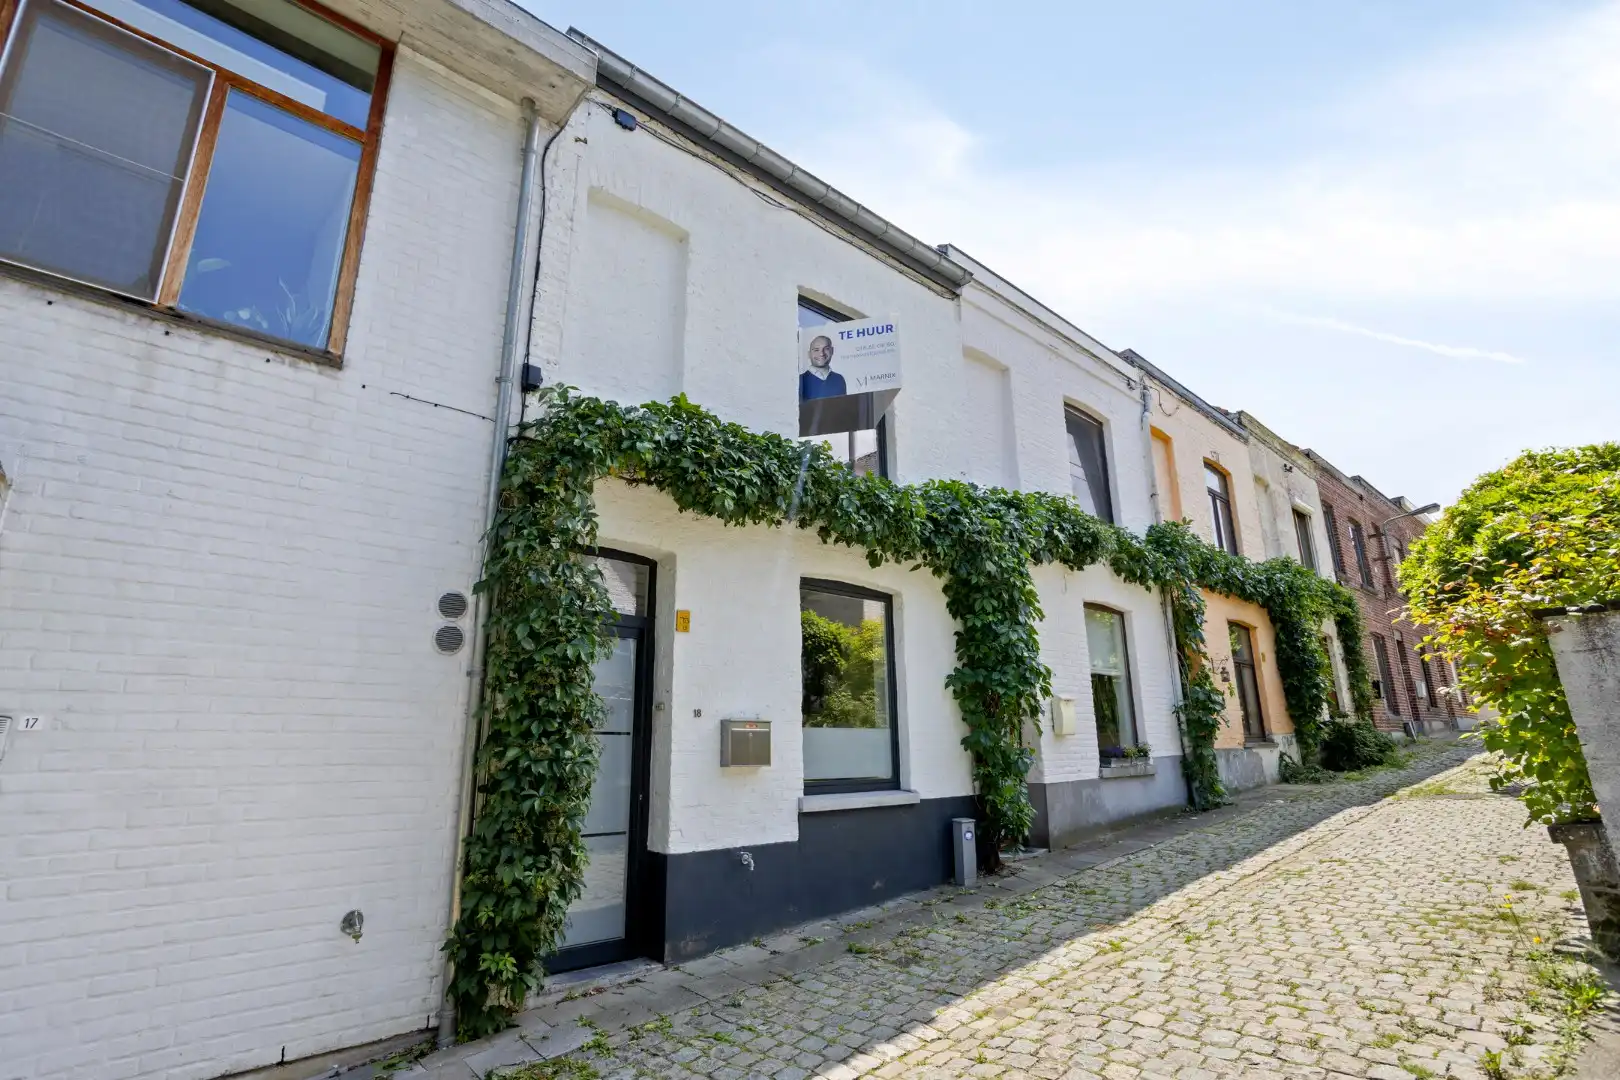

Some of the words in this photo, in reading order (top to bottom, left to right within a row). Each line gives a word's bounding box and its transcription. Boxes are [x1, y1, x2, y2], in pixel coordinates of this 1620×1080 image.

[838, 330, 853, 340] TE
[856, 324, 894, 338] HUUR
[870, 372, 896, 380] MARNIX
[693, 709, 702, 718] 18
[25, 717, 39, 729] 17
